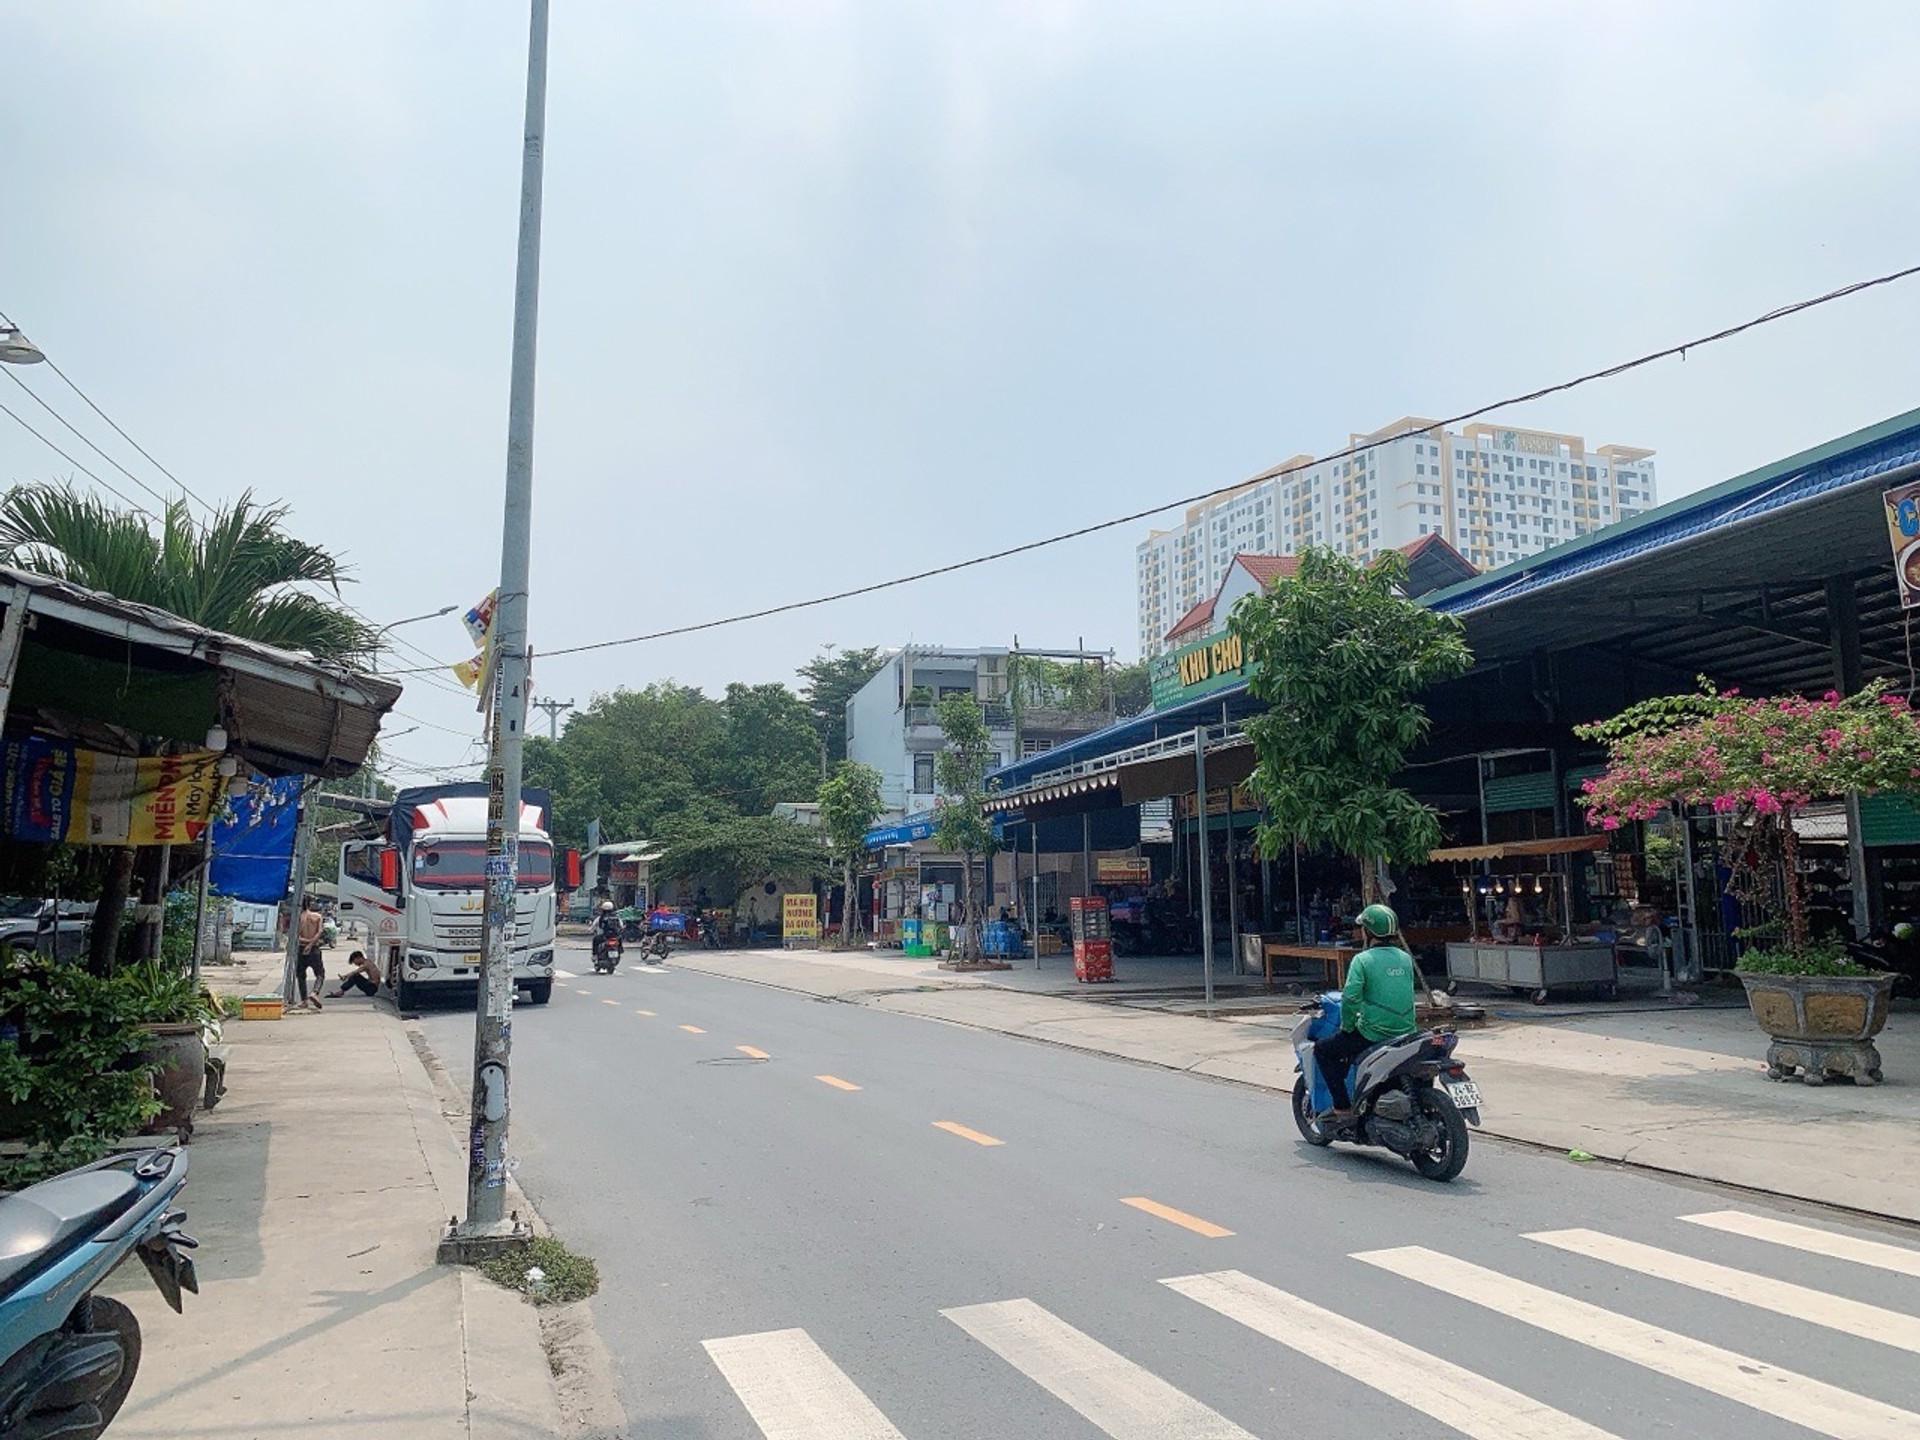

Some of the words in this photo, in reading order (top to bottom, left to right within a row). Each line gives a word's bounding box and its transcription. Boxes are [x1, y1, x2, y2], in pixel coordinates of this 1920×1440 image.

[1180, 648, 1209, 687] KHU
[145, 787, 176, 840] MIỄN
[186, 785, 204, 816] Máy
